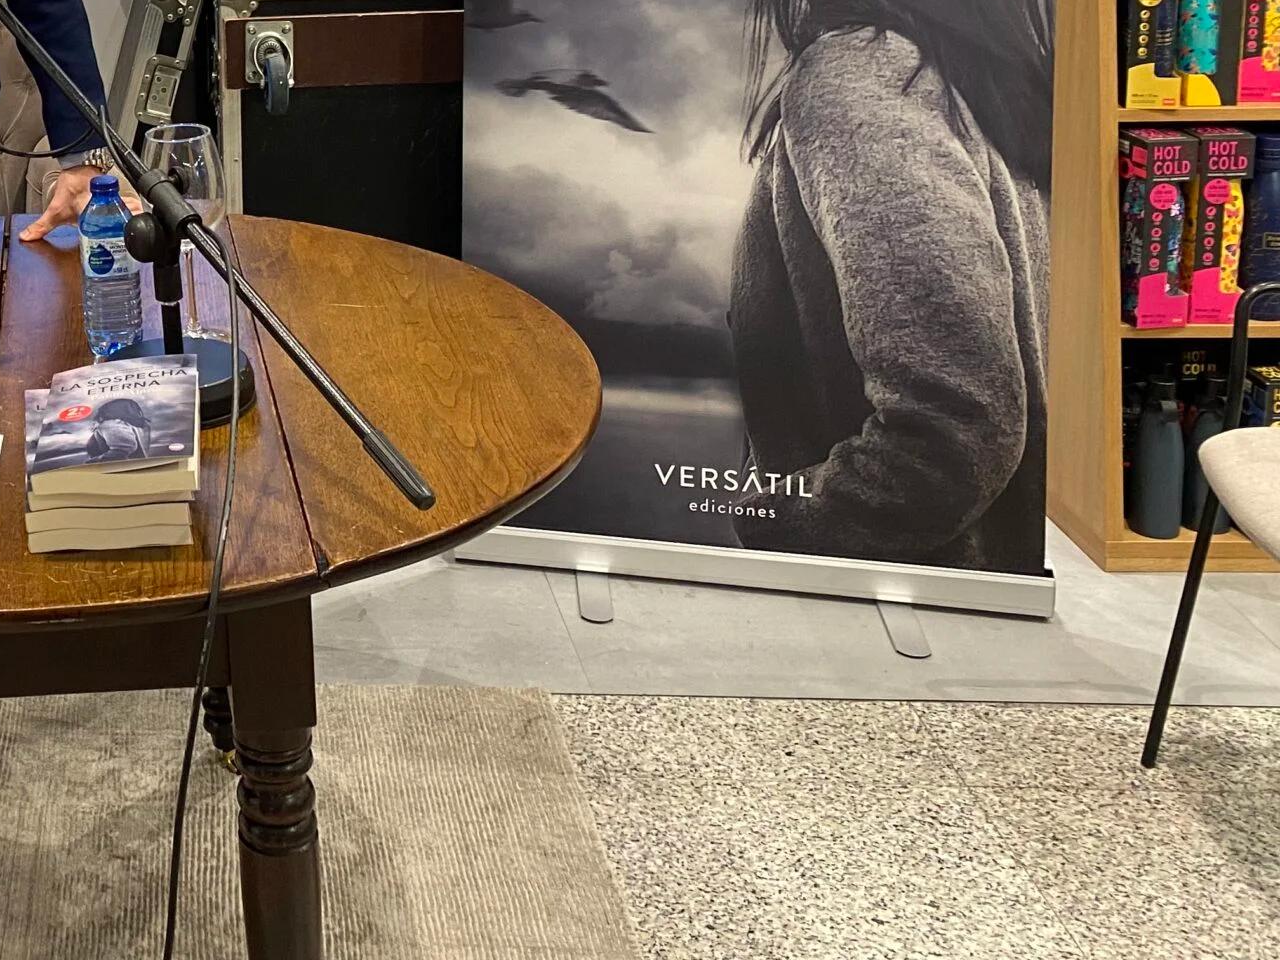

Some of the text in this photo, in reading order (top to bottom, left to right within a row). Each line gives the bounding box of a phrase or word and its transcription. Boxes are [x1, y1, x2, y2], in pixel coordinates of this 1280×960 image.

[1154, 146, 1182, 160] HOT
[1209, 141, 1239, 155] HOT
[1154, 160, 1191, 175] COLD
[1209, 156, 1248, 170] COLD
[61, 369, 188, 393] LA SOSPECHA
[87, 380, 161, 396] ETERNA
[654, 464, 813, 498] VERSÁTIL
[689, 498, 776, 519] ediciones
